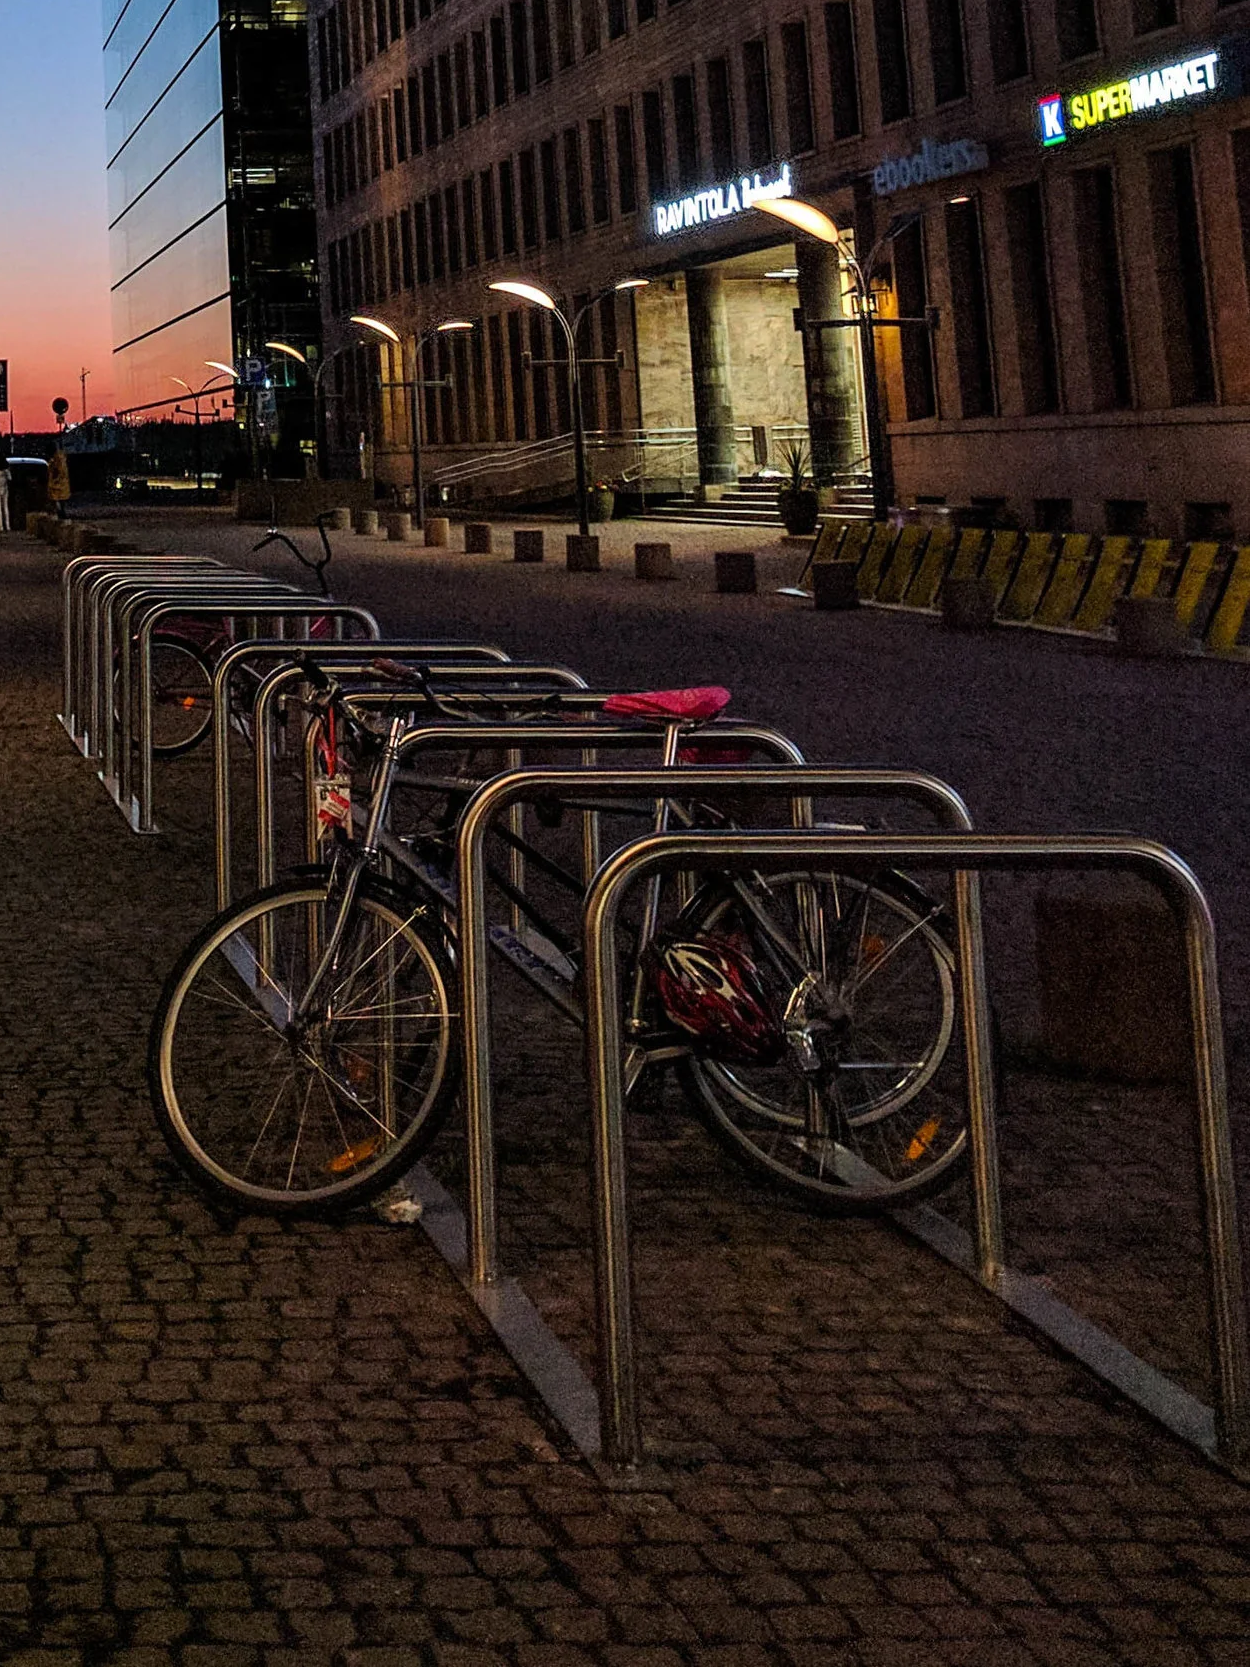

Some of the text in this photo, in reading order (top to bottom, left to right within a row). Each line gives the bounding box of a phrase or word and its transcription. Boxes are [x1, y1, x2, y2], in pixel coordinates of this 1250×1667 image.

[1042, 52, 1218, 138] K SUPERMARKET
[655, 183, 741, 235] RAVINTOLA
